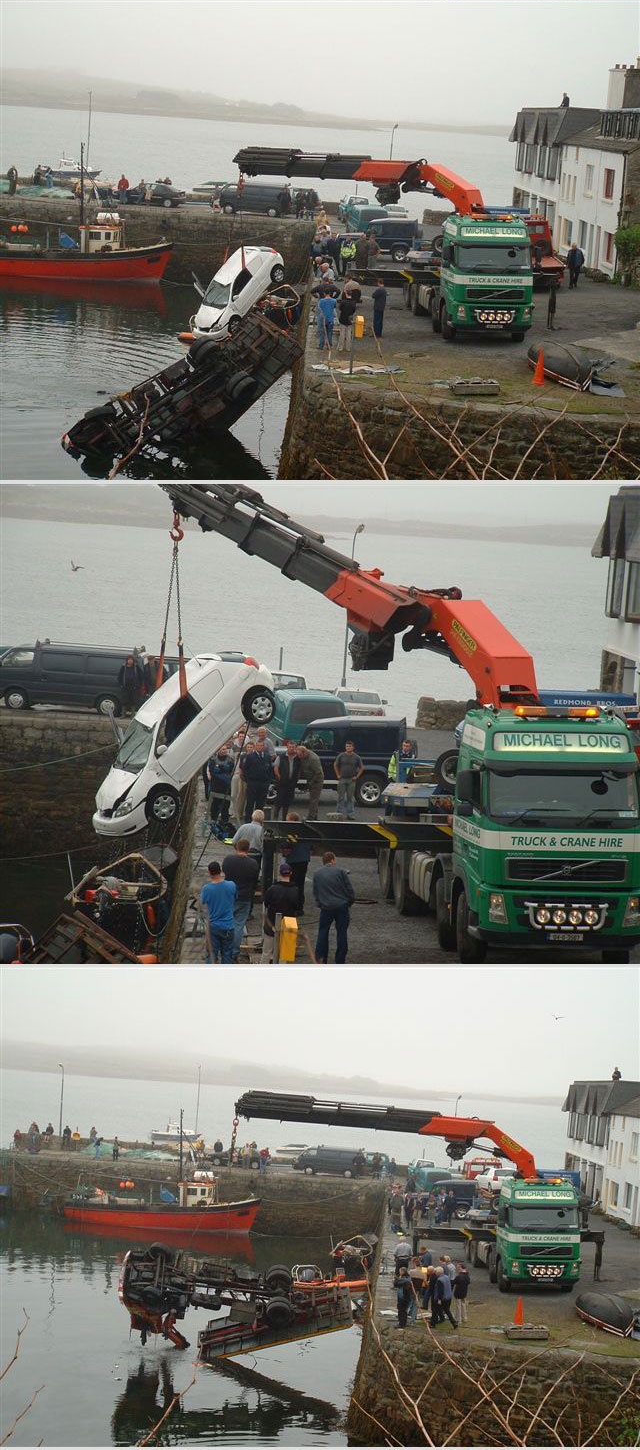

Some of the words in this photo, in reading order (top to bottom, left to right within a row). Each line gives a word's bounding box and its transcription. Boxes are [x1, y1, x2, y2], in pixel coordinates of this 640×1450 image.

[465, 227, 499, 235] MICHAEL
[501, 227, 523, 235] LONG
[503, 734, 572, 747] MICHAEL
[578, 735, 621, 748] LONG
[511, 836, 547, 847] TRUCK
[549, 837, 557, 846] &
[559, 836, 596, 847] CRANE
[599, 837, 624, 848] HIRE
[518, 1190, 549, 1198] MICHAEL
